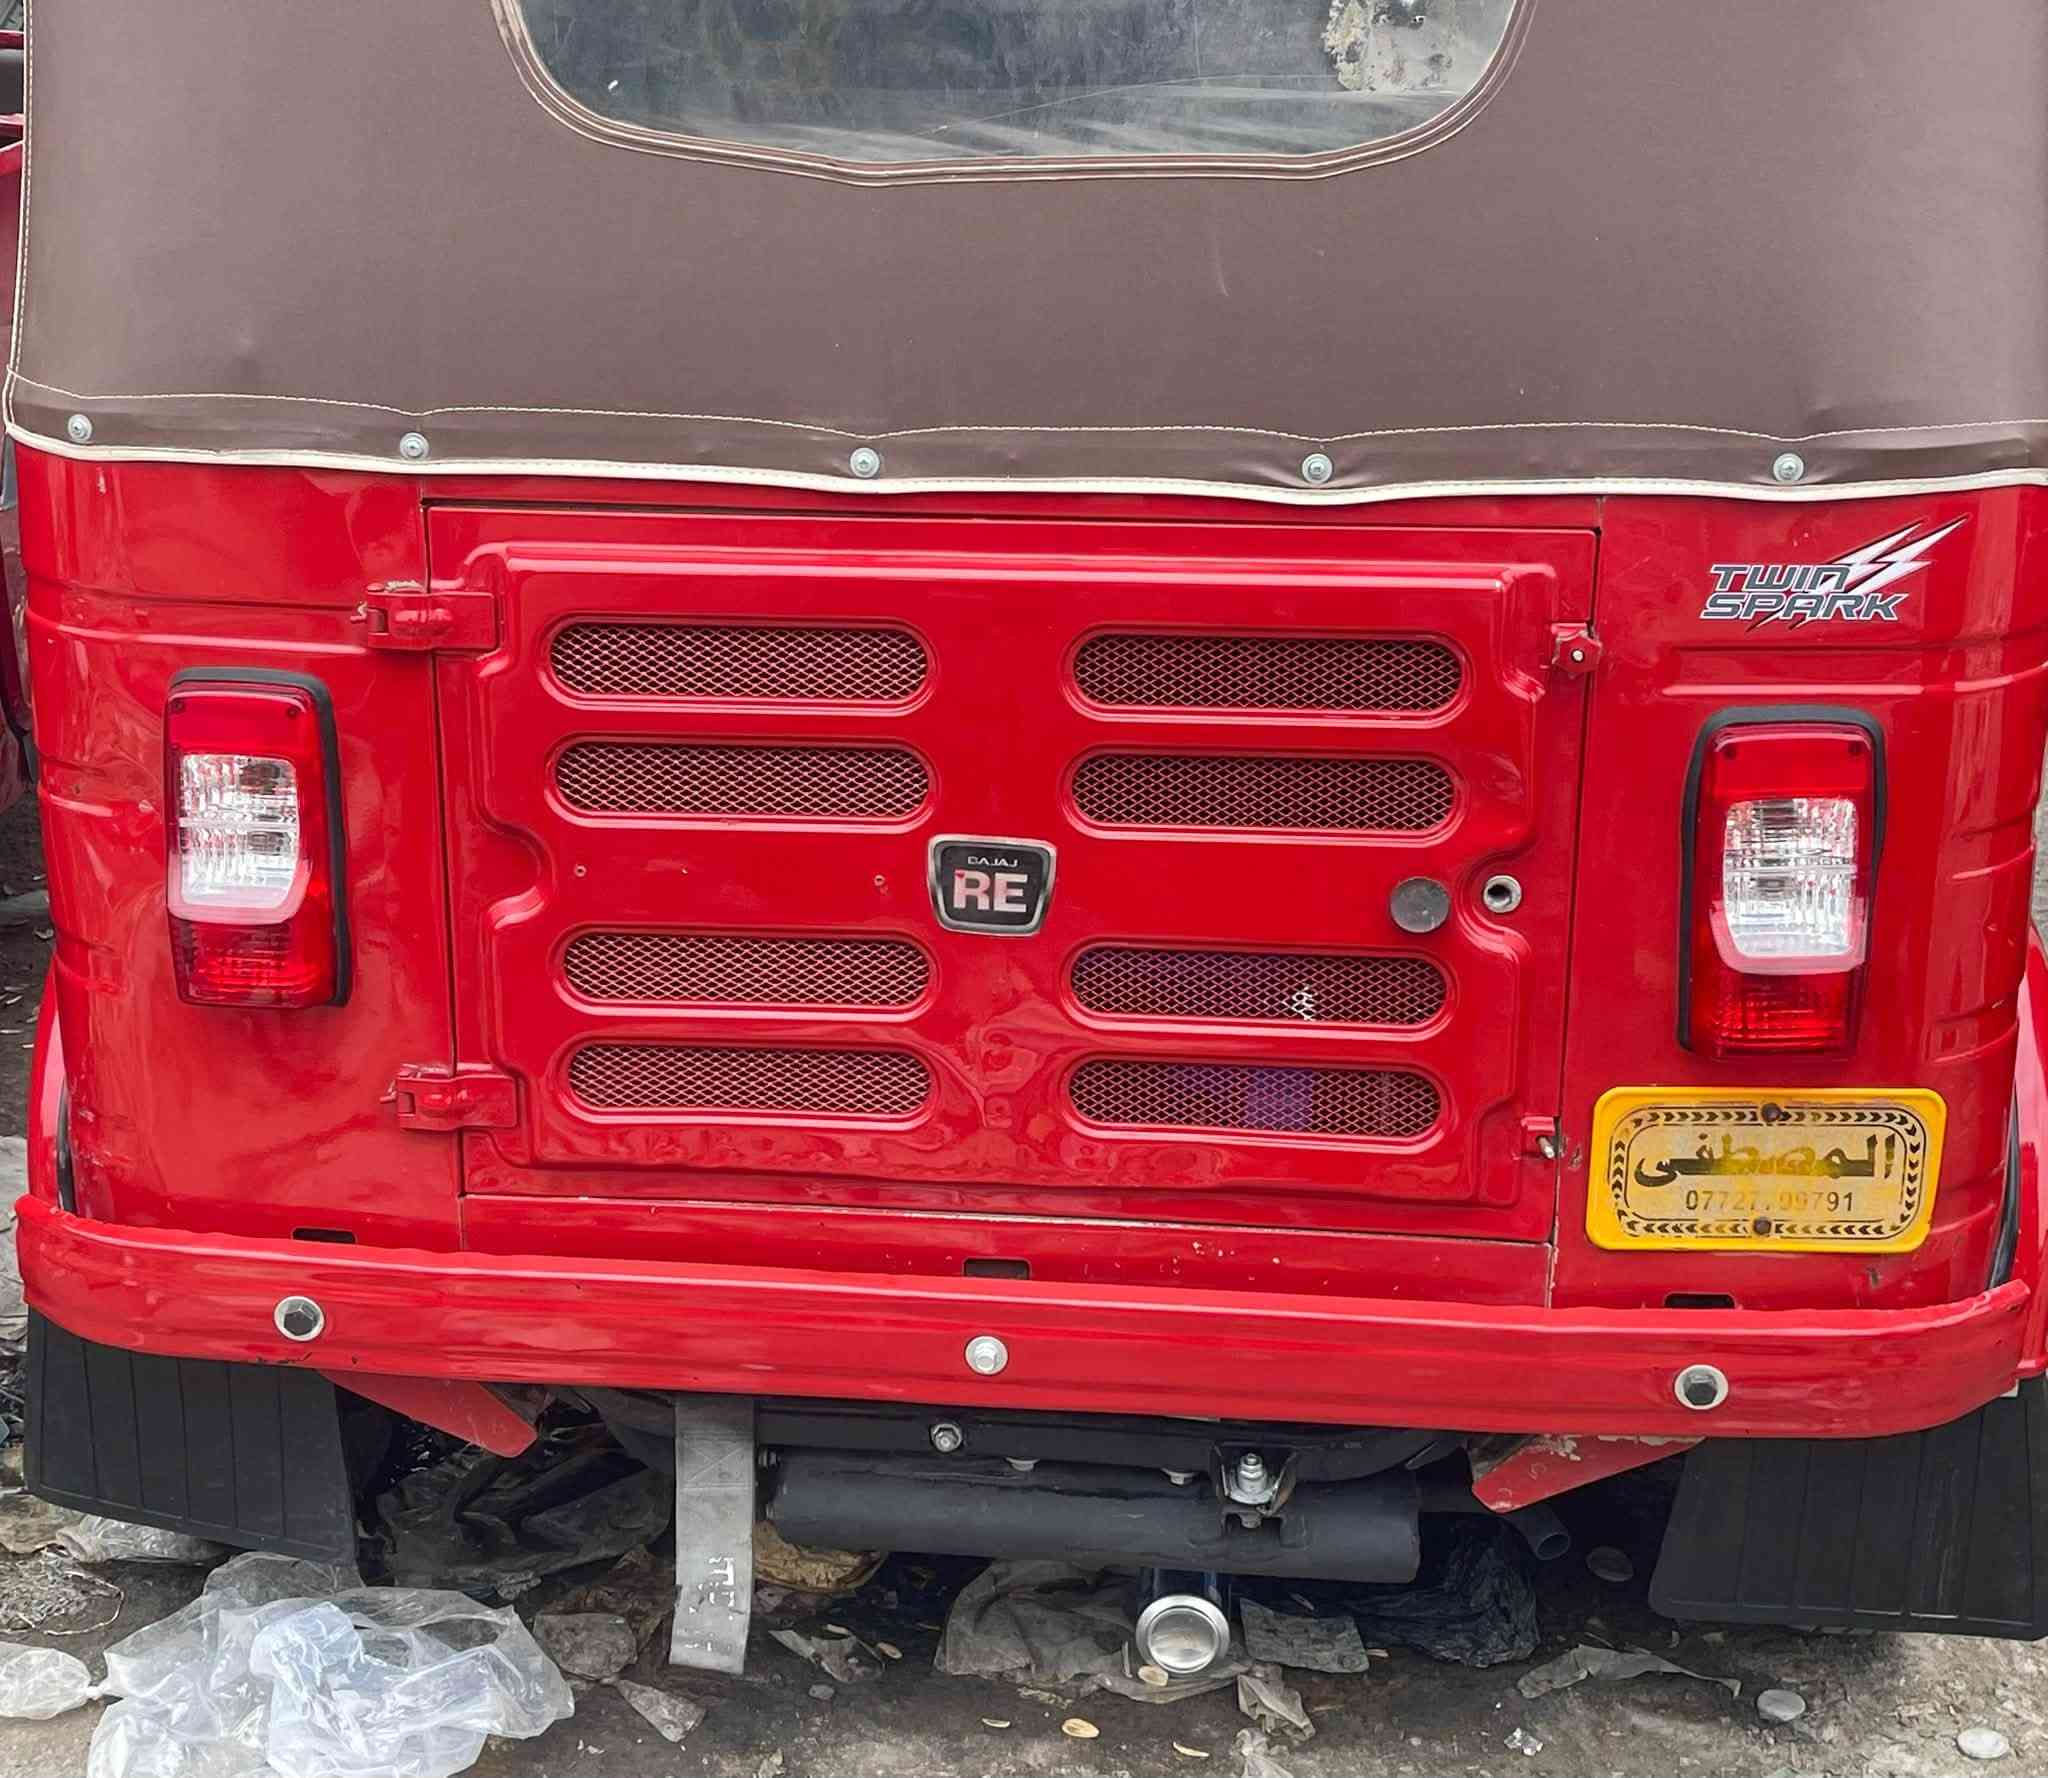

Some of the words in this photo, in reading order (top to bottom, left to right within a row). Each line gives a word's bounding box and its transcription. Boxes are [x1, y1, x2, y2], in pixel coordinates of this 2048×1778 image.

[1710, 564, 1851, 592] TWIN
[1699, 593, 1909, 621] SPARK
[953, 869, 1028, 913] RE
